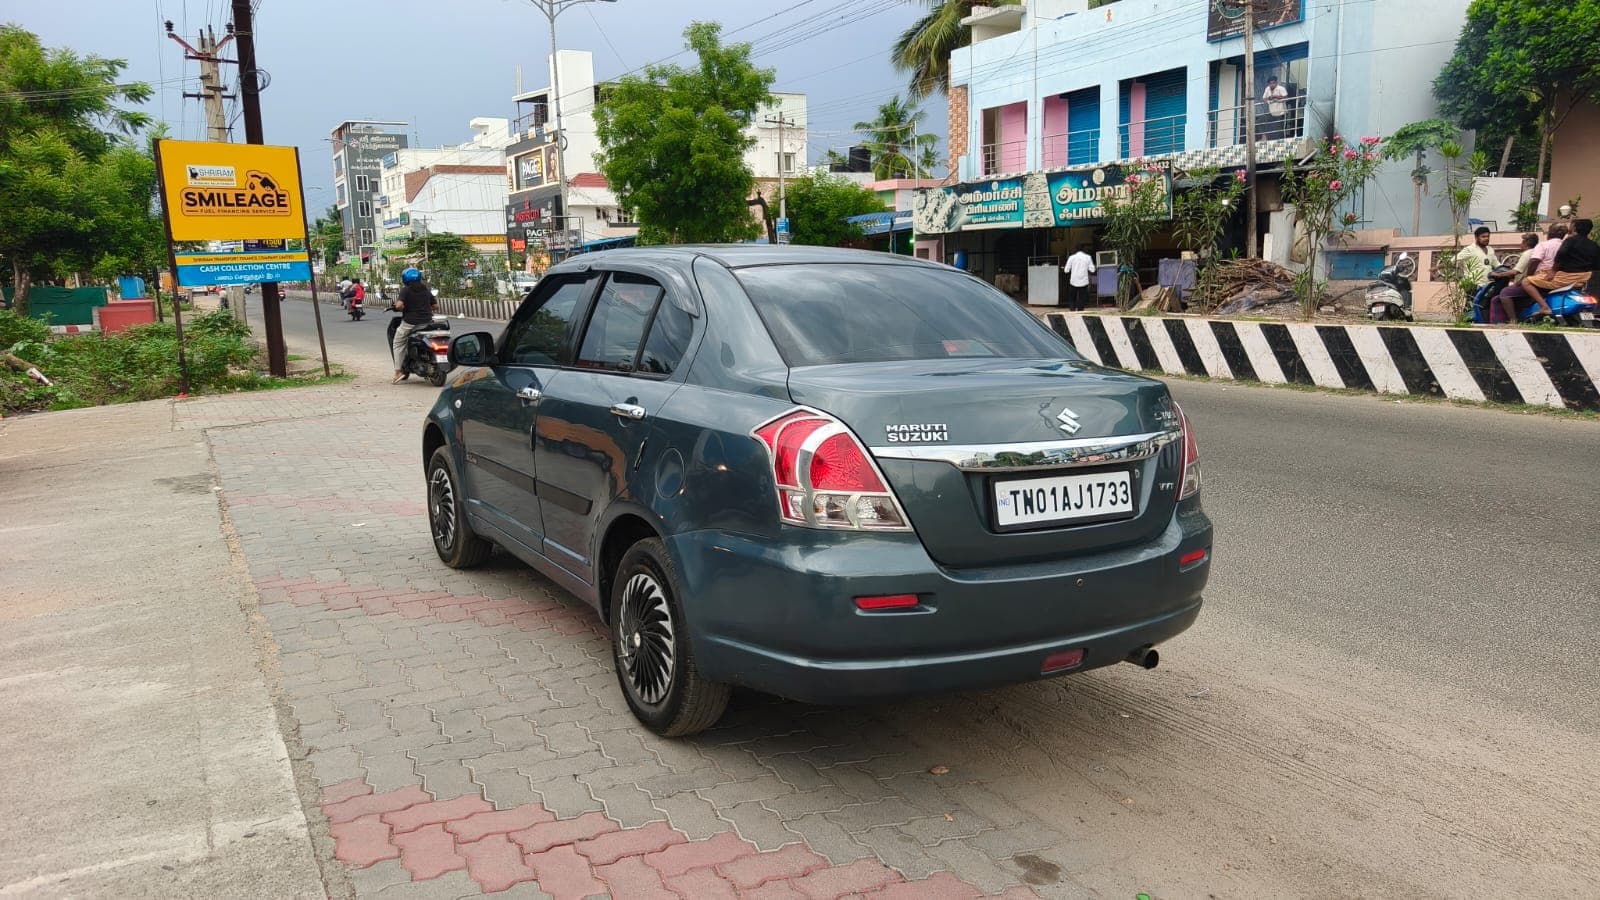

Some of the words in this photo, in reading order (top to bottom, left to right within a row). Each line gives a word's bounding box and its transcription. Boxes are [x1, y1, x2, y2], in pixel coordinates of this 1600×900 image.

[199, 168, 234, 177] SHRIRAM
[184, 192, 288, 208] SMILEAGE
[200, 265, 220, 273] CASH
[221, 264, 264, 272] COLLECTION
[886, 424, 947, 432] MARUTI
[887, 432, 948, 442] SUZUKI
[1009, 480, 1130, 517] TN01AJ1733
